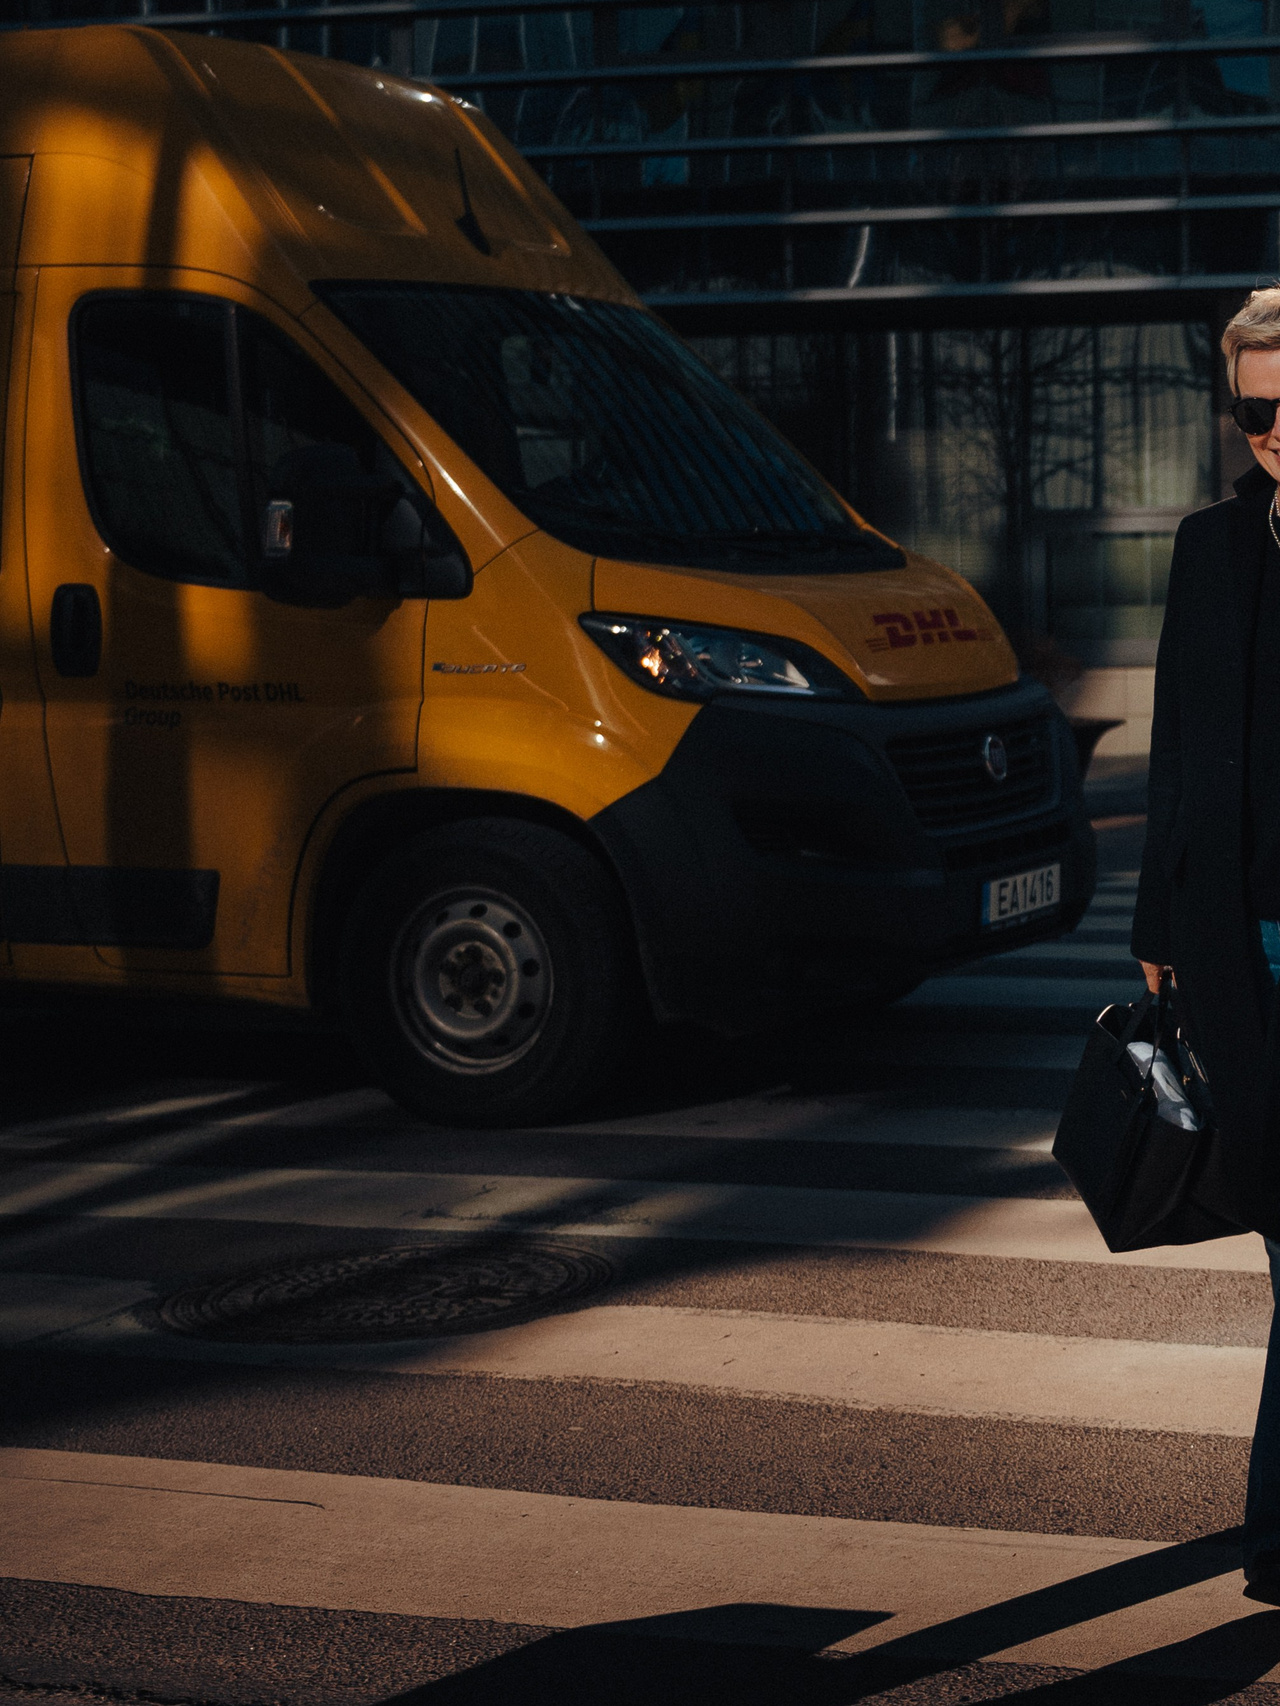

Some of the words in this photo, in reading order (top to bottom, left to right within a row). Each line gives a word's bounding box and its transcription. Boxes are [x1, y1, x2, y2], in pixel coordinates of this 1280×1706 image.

[873, 609, 977, 648] DHL
[125, 680, 213, 701] Deutsche
[217, 683, 260, 702] Post
[264, 683, 305, 702] DHL
[124, 706, 182, 728] Group
[998, 869, 1054, 916] EA1416
